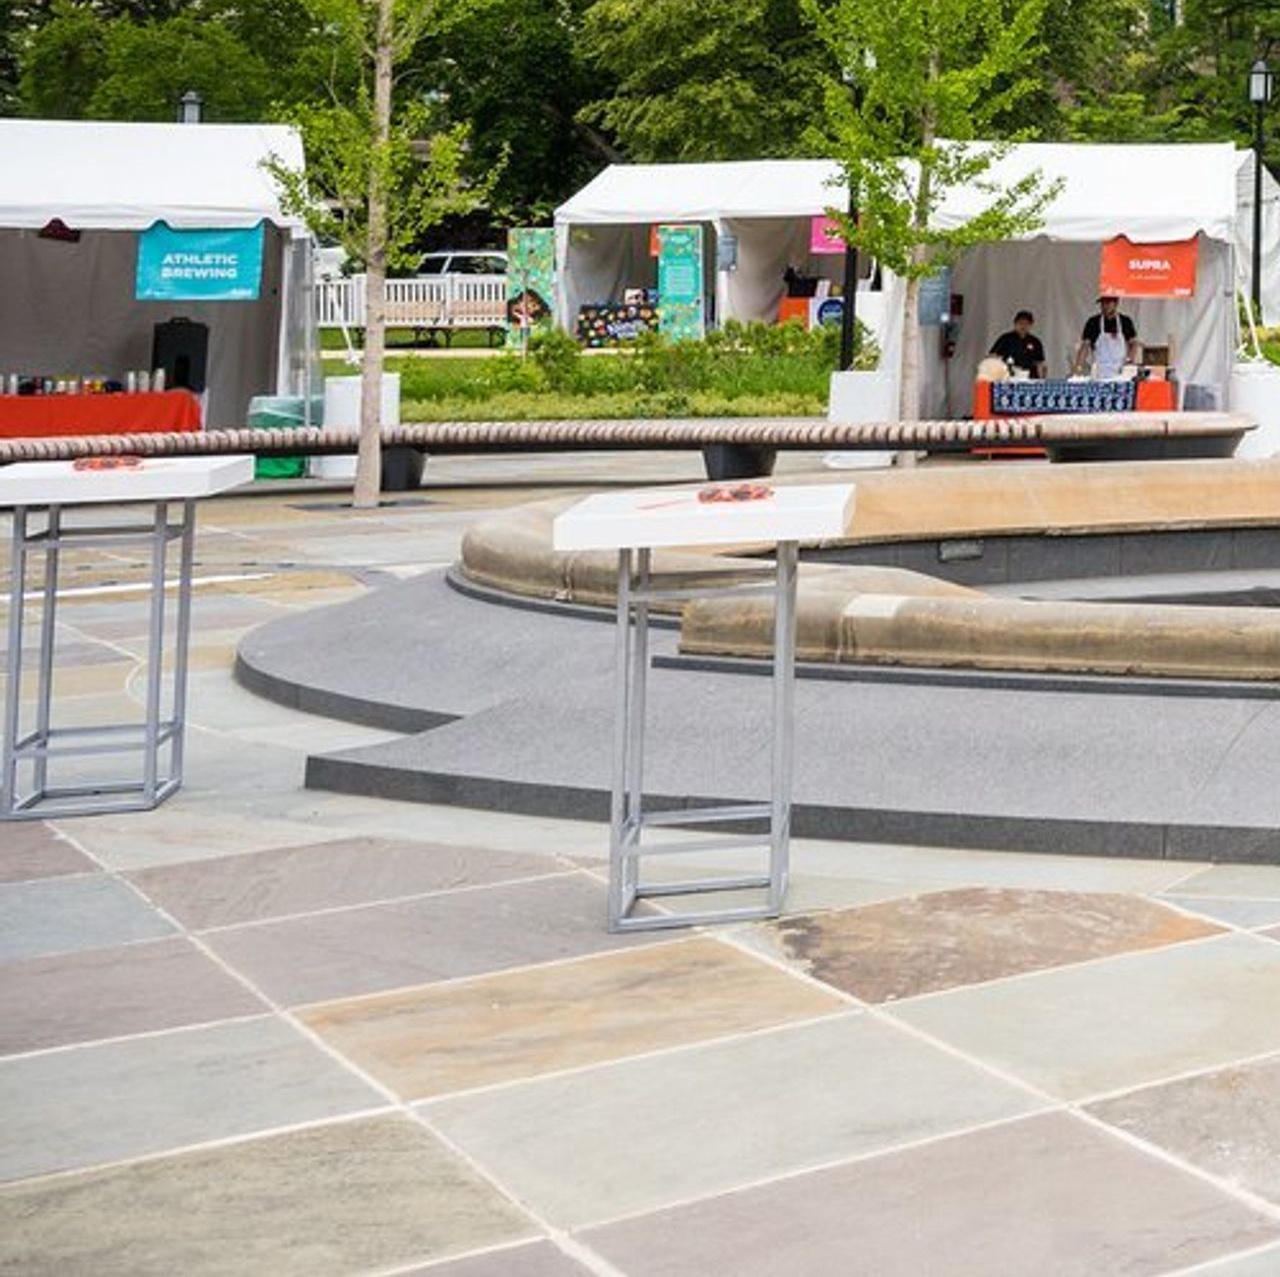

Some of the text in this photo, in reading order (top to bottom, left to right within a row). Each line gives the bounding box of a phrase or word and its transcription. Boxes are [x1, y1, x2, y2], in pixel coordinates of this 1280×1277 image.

[161, 252, 239, 265] ATHLETIC
[1128, 259, 1172, 270] SUPRA
[160, 267, 238, 279] BREWING
